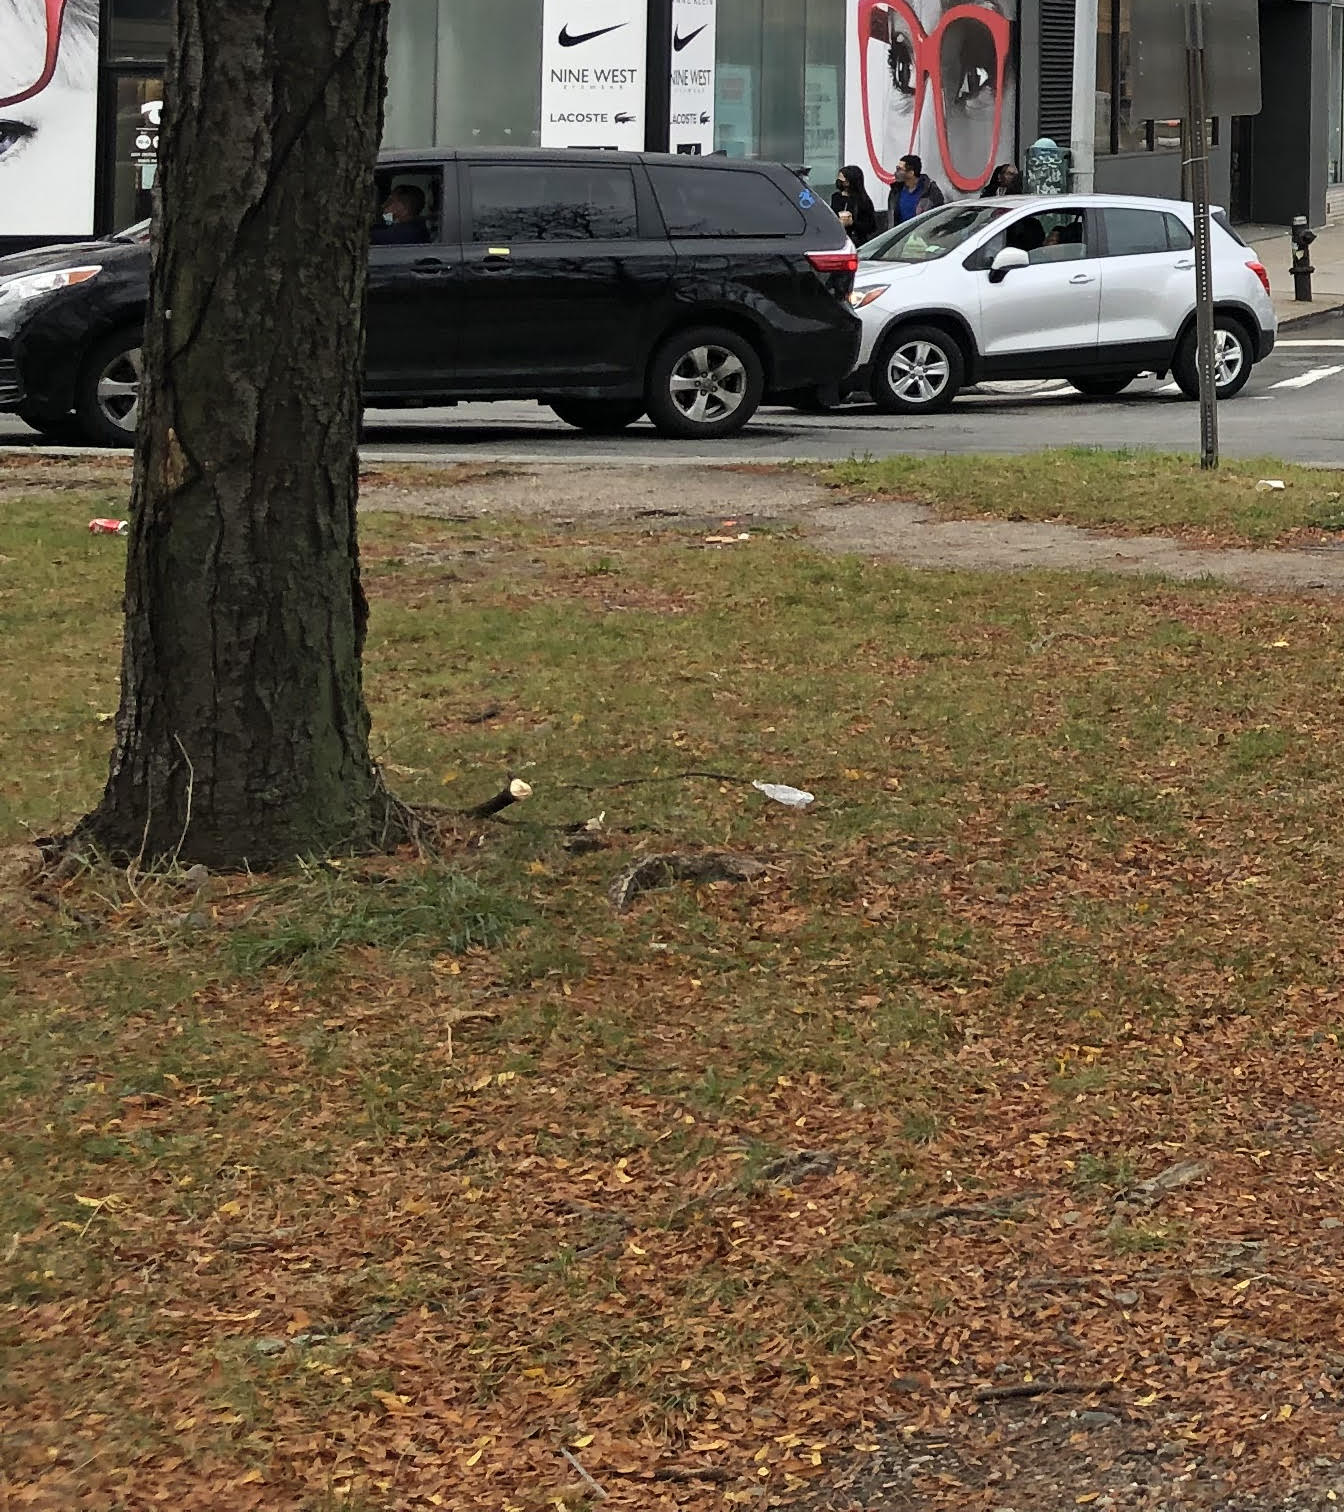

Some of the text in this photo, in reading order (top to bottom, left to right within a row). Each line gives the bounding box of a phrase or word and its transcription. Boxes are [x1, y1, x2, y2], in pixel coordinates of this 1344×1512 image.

[551, 69, 637, 84] NINE WEST
[690, 69, 712, 86] WEST
[550, 113, 609, 123] LACOSTE
